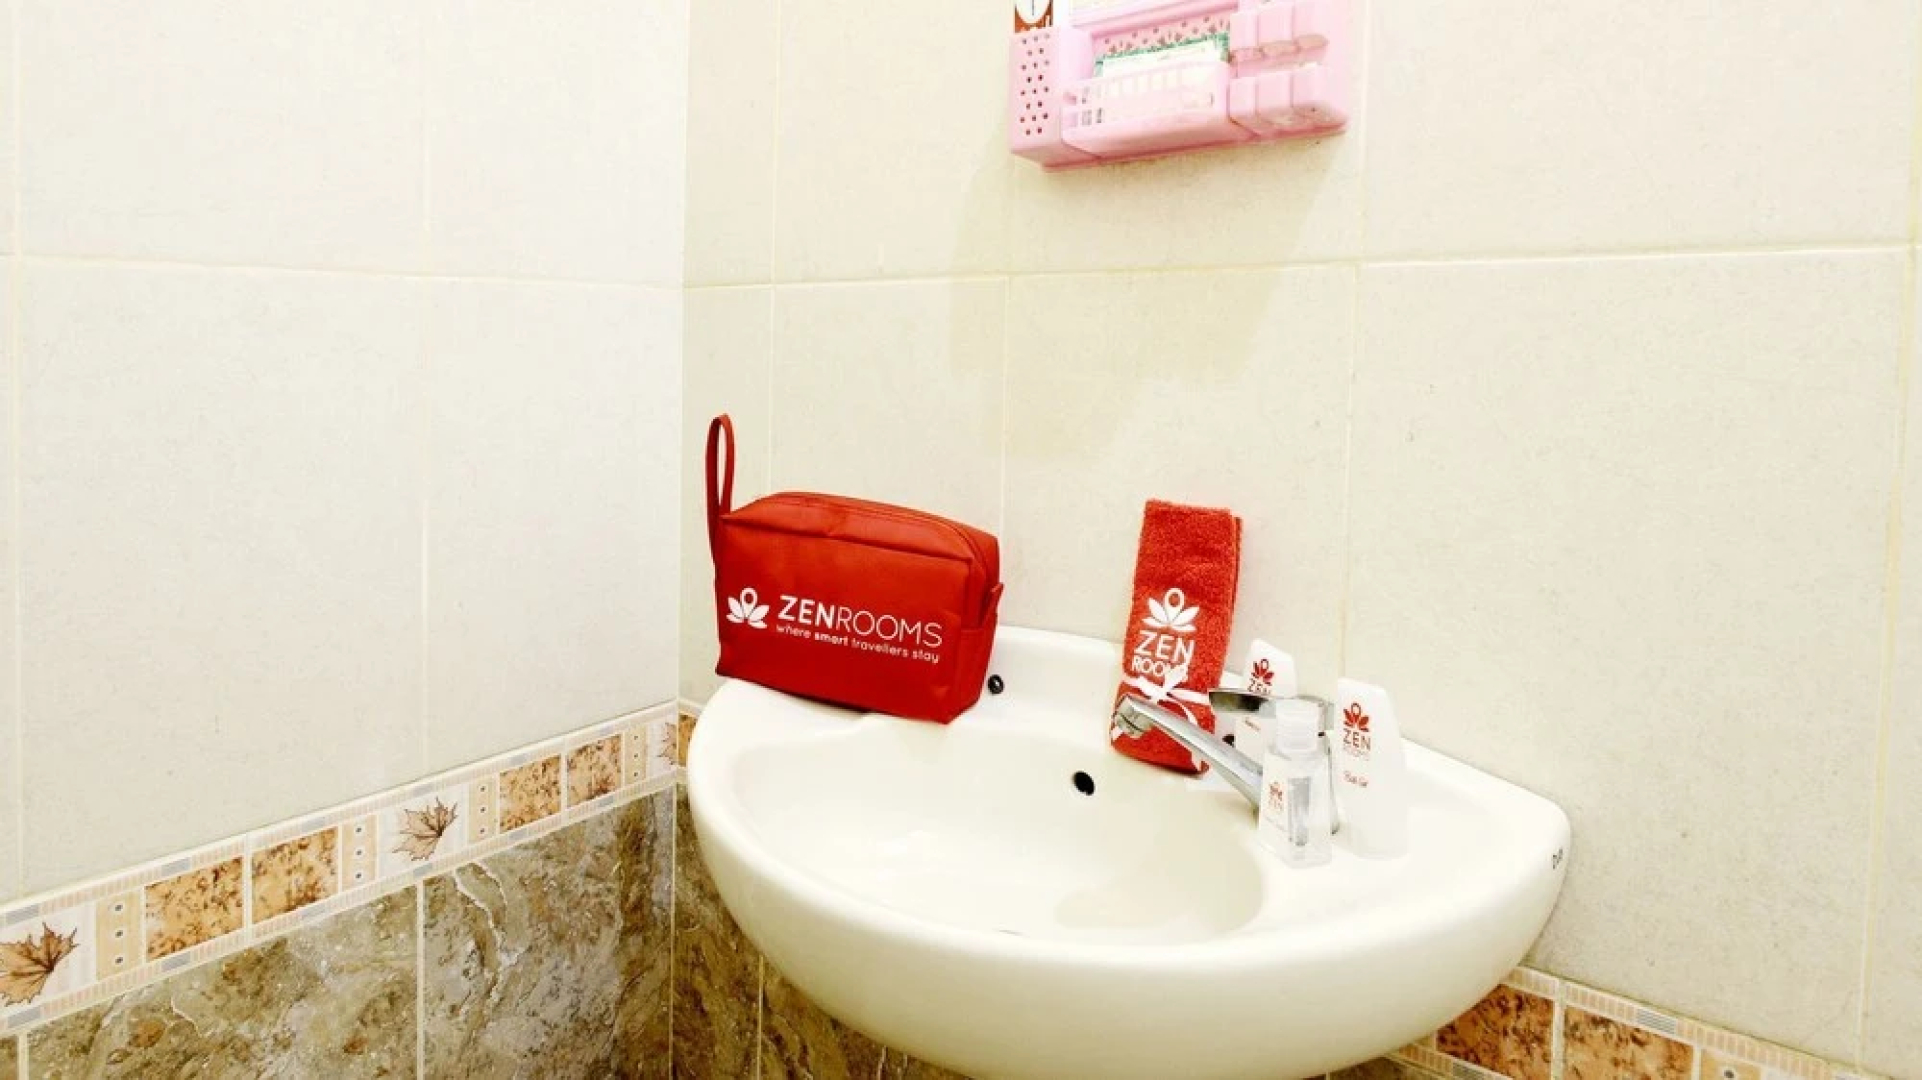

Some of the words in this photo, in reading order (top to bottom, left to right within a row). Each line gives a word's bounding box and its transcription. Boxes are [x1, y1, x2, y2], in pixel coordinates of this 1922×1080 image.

[777, 594, 943, 648] ZENROOMS
[776, 624, 812, 639] where
[814, 630, 849, 646] smart
[852, 637, 909, 658] travellers
[912, 649, 940, 664] stay
[1133, 629, 1195, 662] ZEN
[1343, 728, 1371, 751] ZEN
